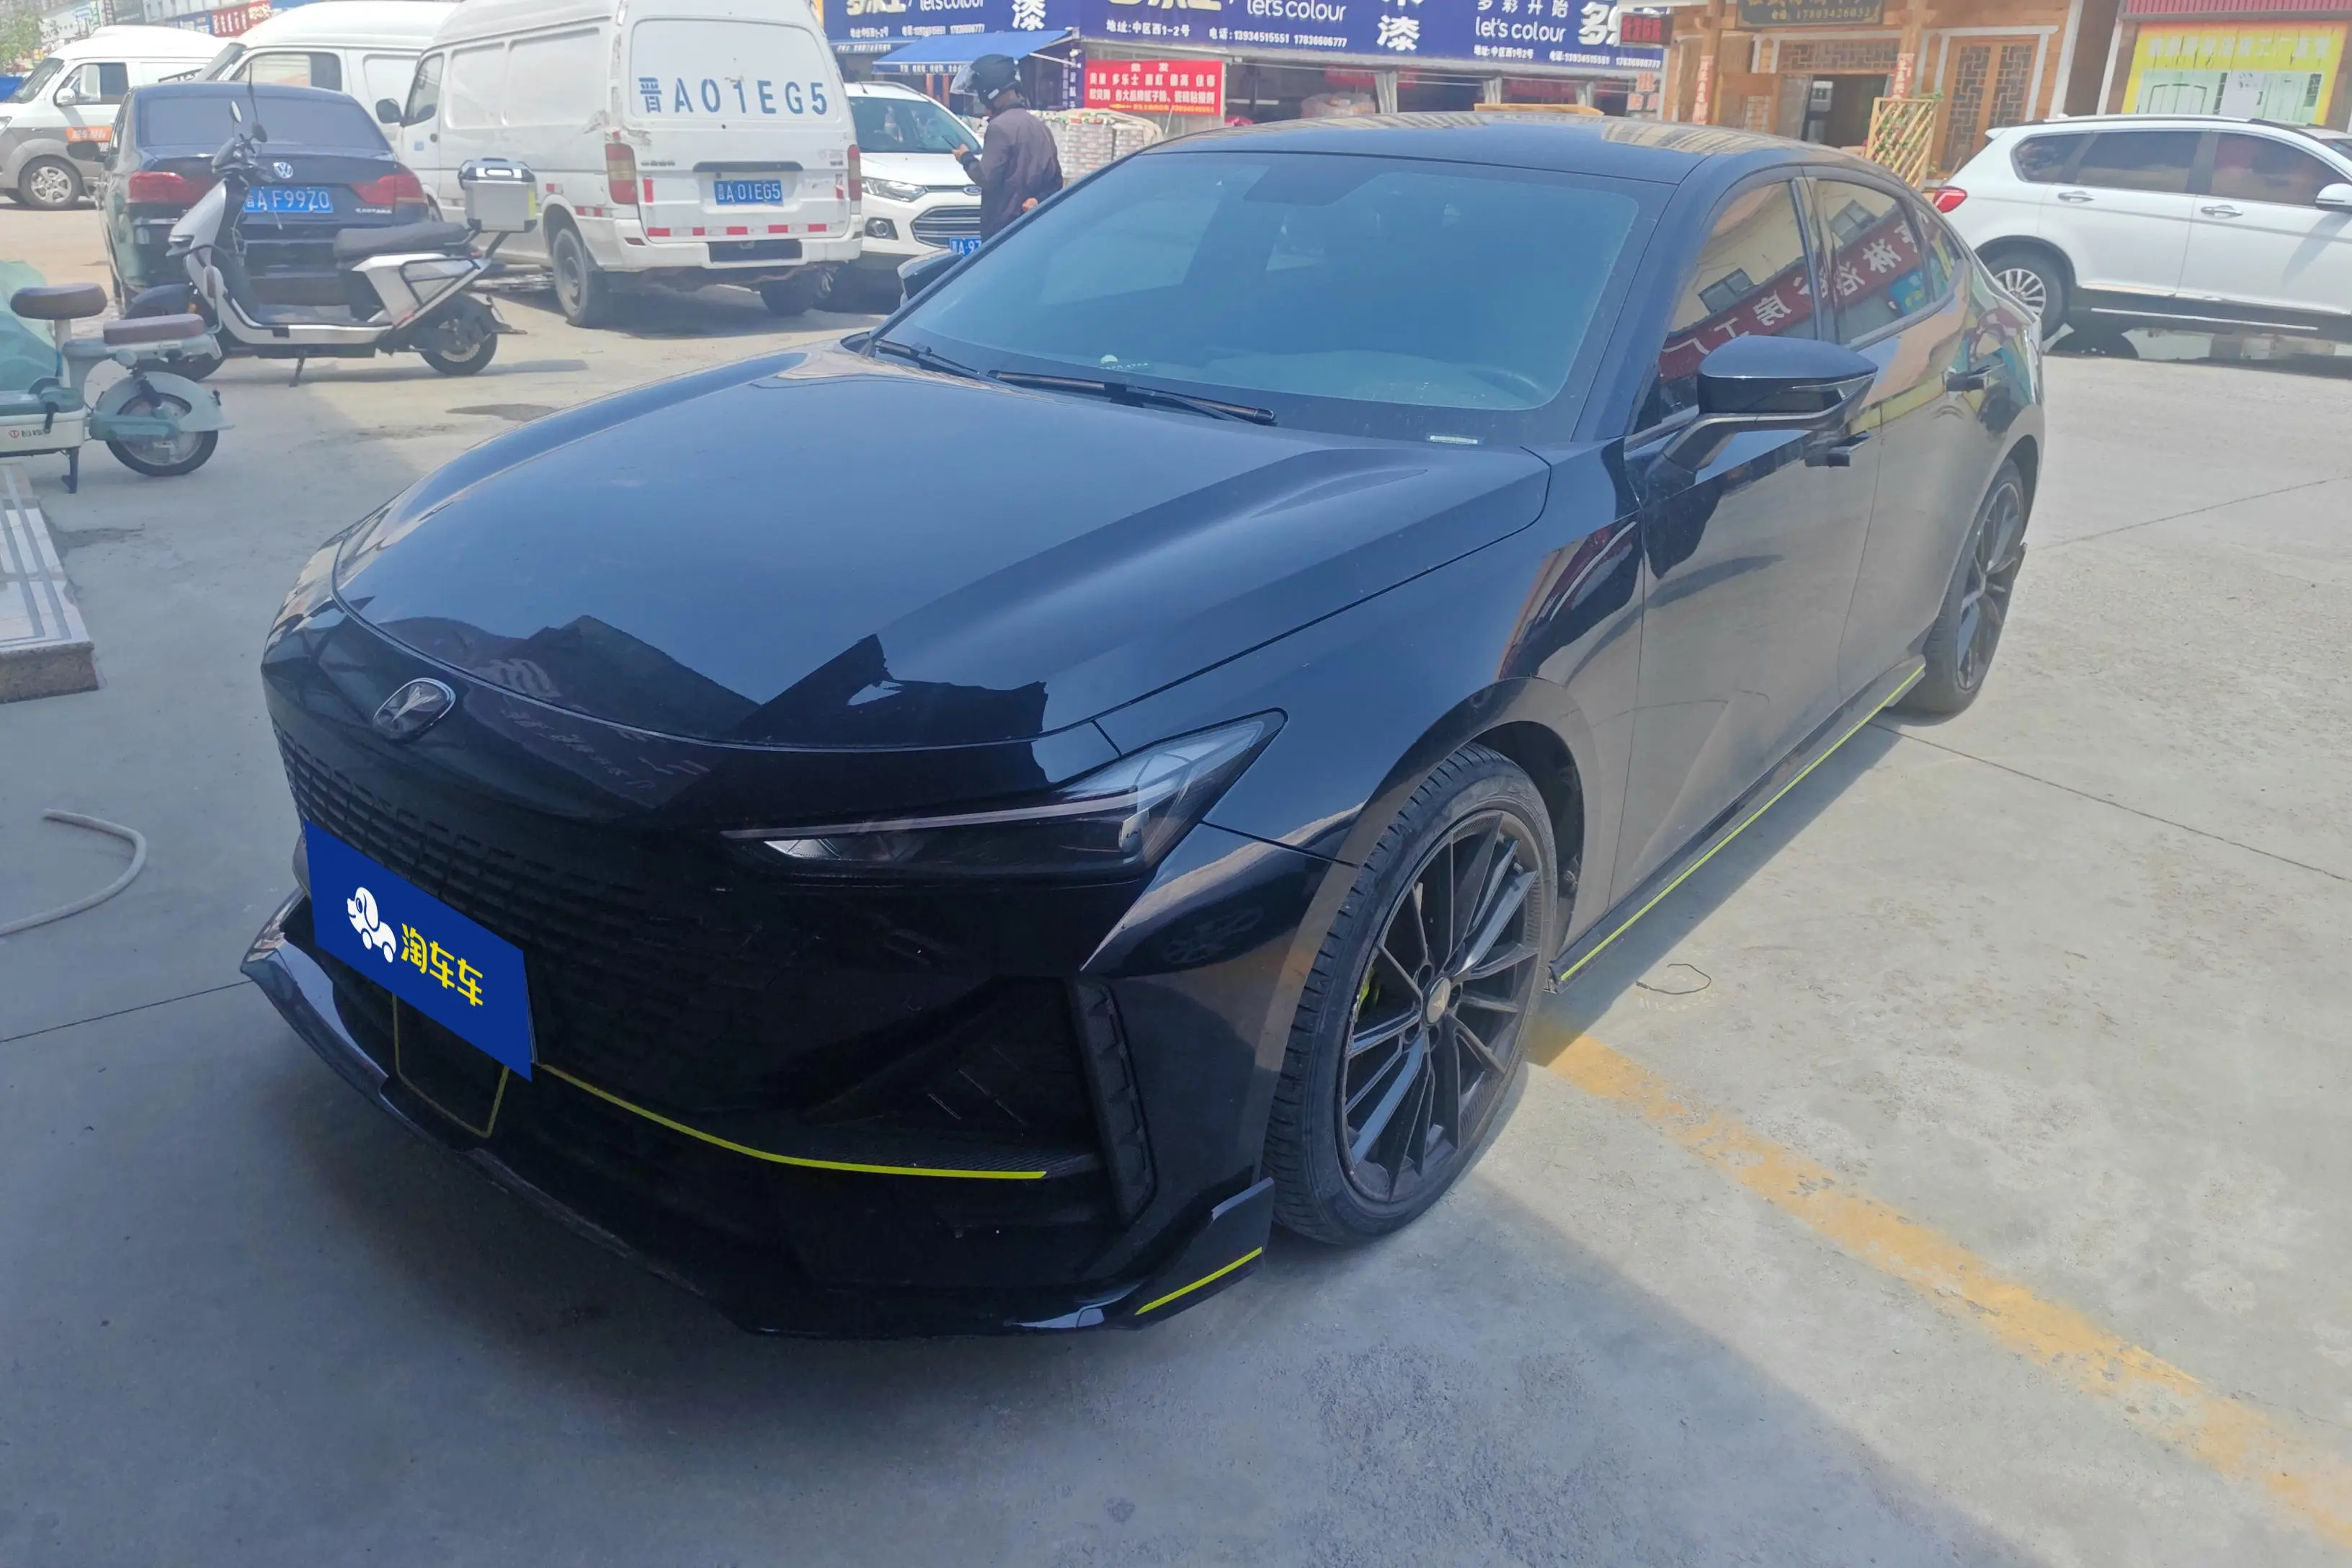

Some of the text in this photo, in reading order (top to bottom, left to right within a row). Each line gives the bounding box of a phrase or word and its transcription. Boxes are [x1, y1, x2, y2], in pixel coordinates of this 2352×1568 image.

[1010, 0, 1046, 30] 漆
[1285, 0, 1347, 21] colour
[1376, 14, 1421, 51] 漆
[1476, 16, 1566, 43] let's colour
[638, 77, 827, 115] 晋A01EG5
